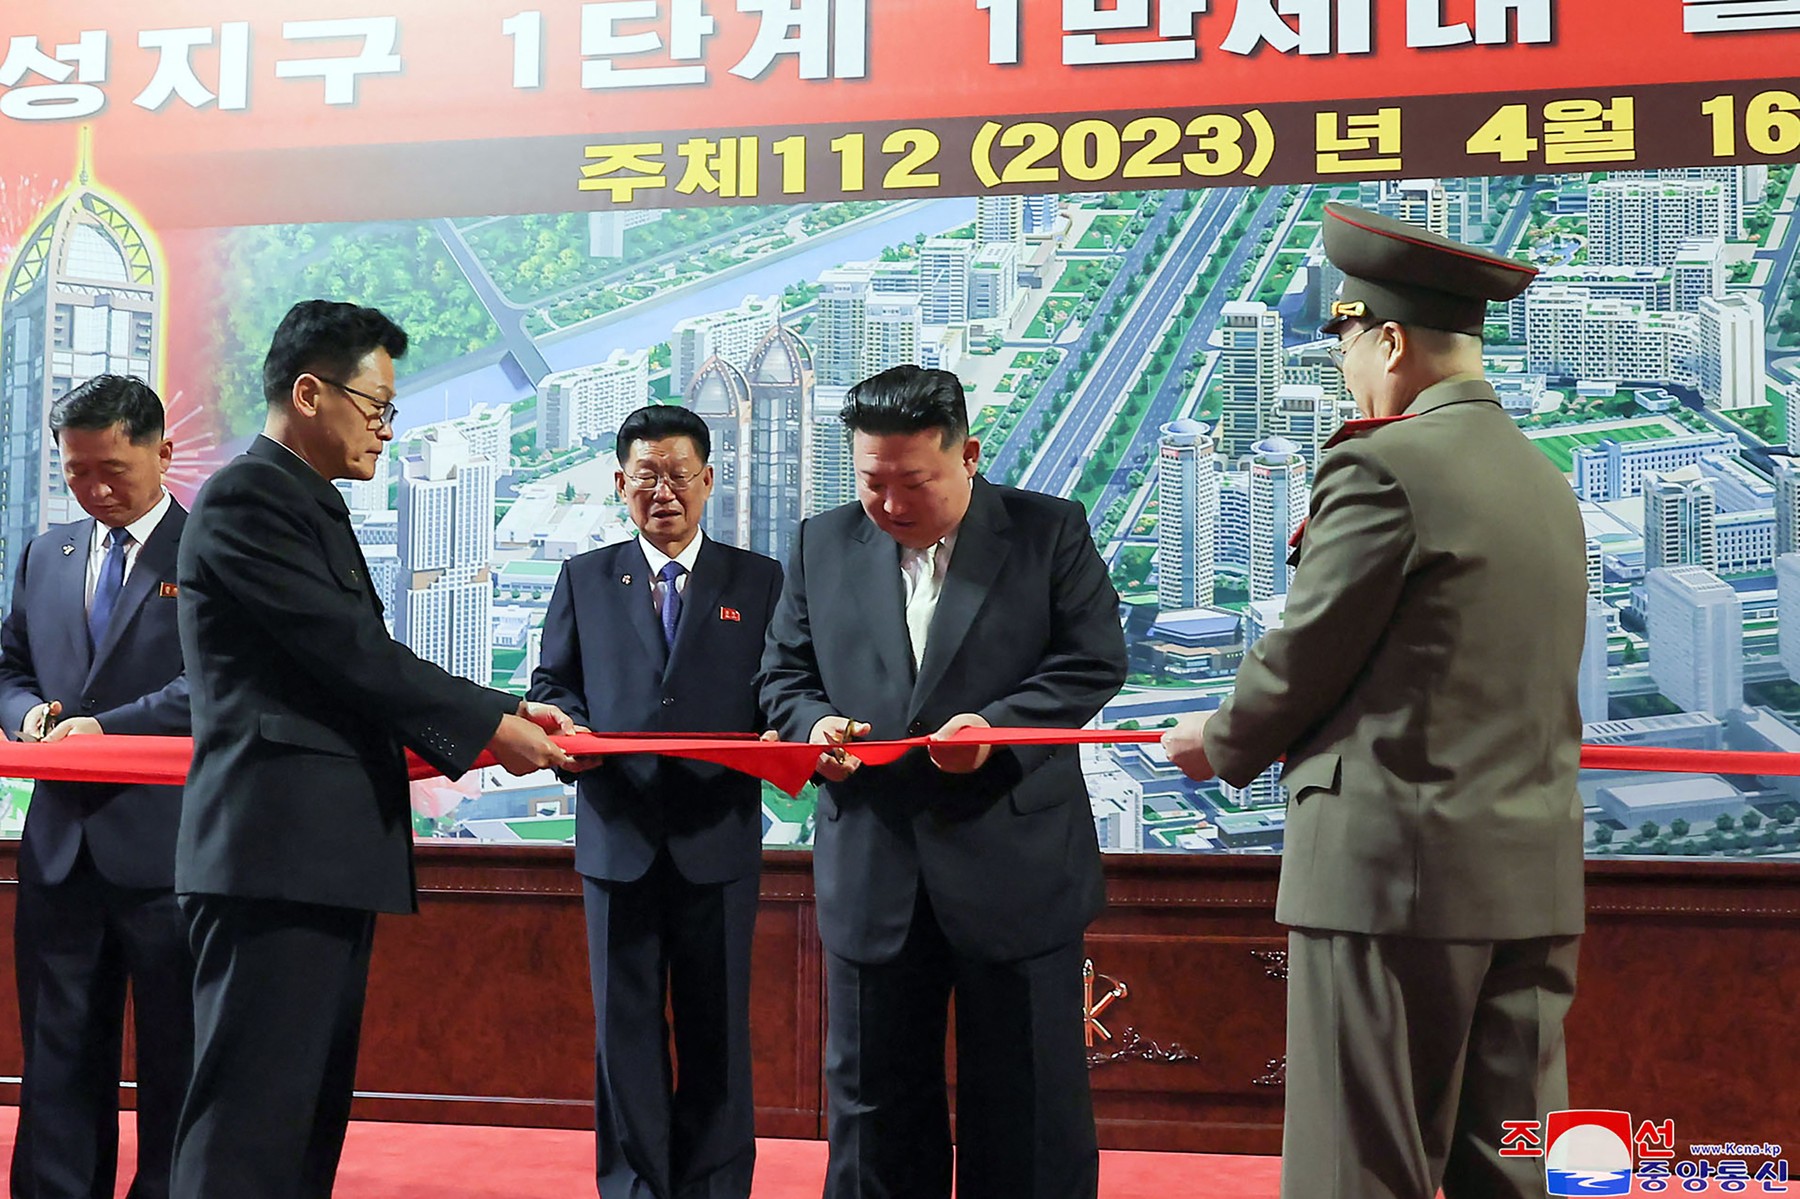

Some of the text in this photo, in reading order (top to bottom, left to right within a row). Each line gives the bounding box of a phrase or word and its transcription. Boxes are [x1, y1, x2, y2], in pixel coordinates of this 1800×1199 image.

[0, 16, 401, 120] 성지구
[502, 0, 866, 89] 1단계
[1465, 96, 1636, 165] 4월
[1701, 91, 1800, 158] 16
